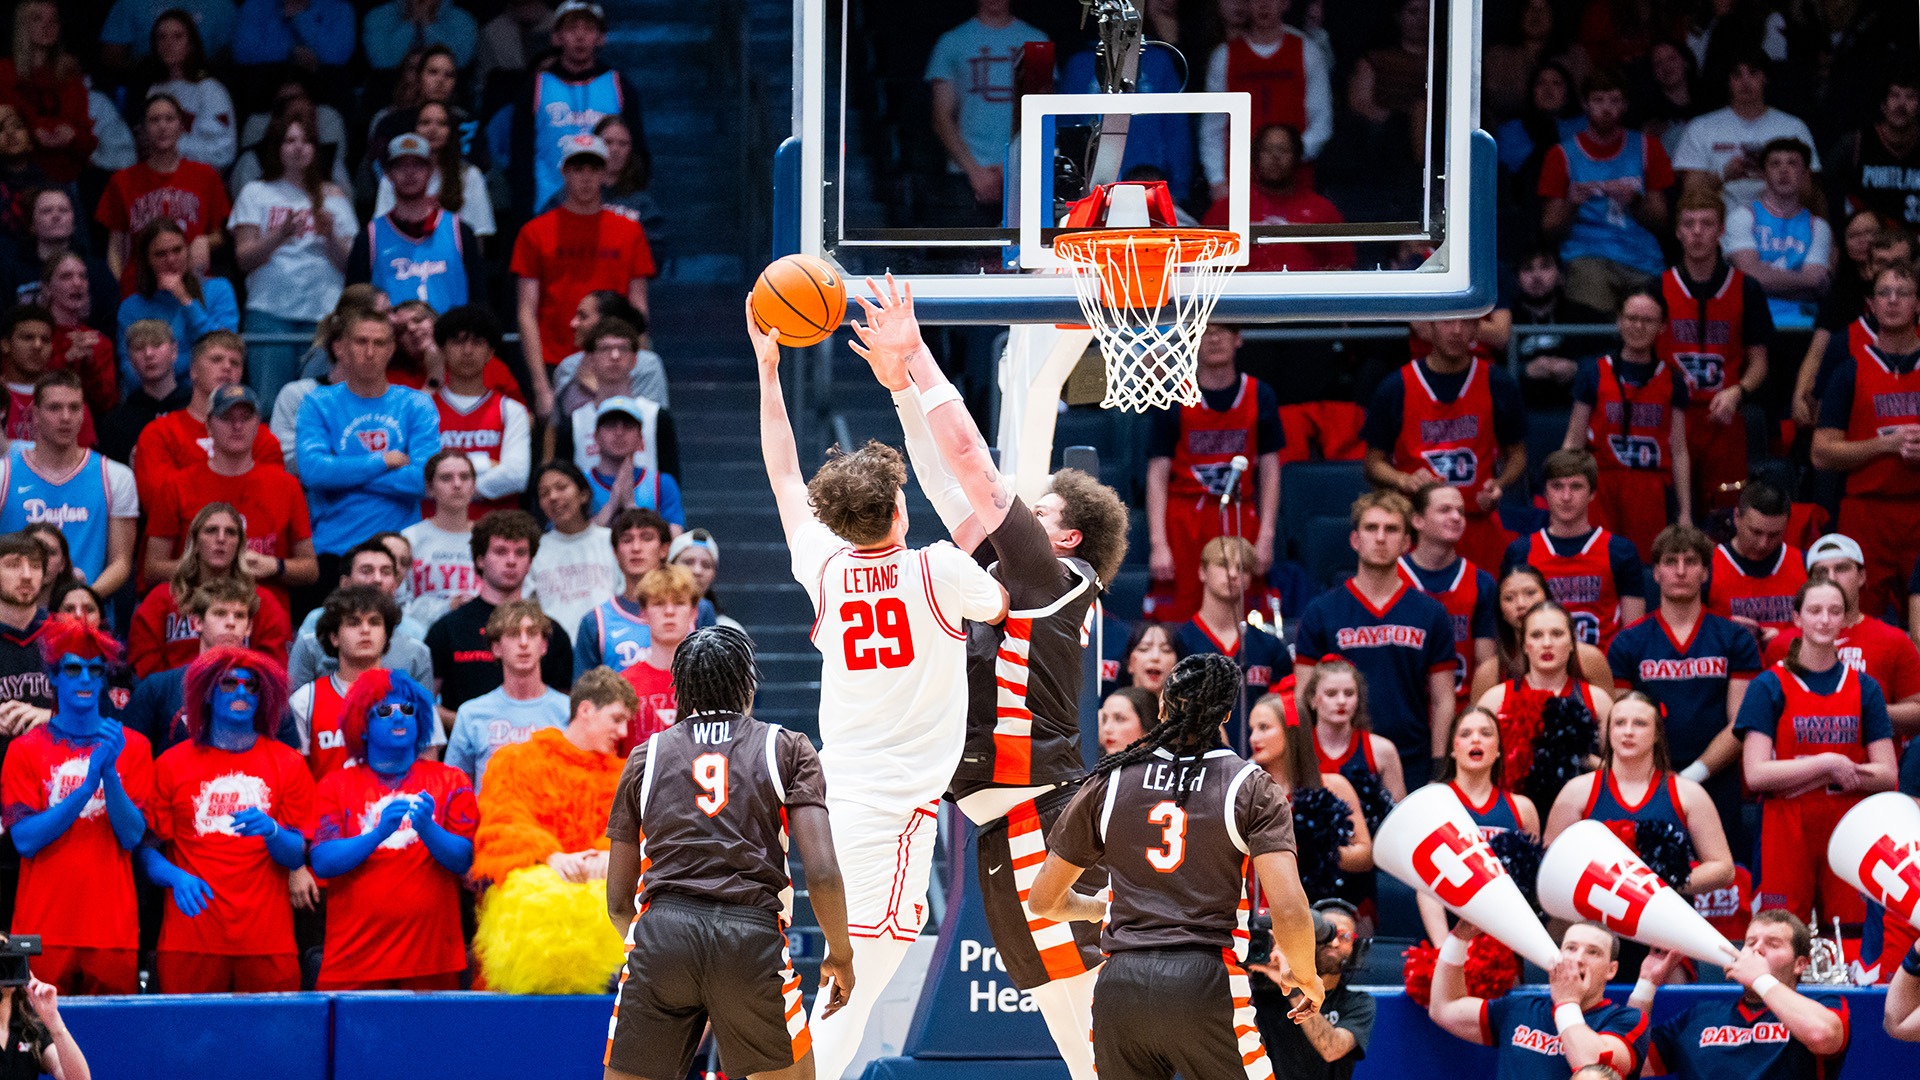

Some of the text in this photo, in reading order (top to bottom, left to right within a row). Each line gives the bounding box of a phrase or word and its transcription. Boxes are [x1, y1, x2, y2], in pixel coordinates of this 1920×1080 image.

[440, 419, 500, 448] AYTON
[23, 498, 89, 530] Dayton
[844, 564, 898, 593] L'ETANG
[840, 597, 915, 671] 29
[1336, 624, 1426, 650] DAYTON
[1640, 656, 1728, 681] DAYTON
[693, 720, 733, 745] WOL
[1793, 715, 1859, 730] DAYTON
[1796, 729, 1858, 744] FLYERS
[692, 751, 729, 818] 9
[1145, 799, 1188, 873] 3
[1700, 1022, 1791, 1048] DAYTON
